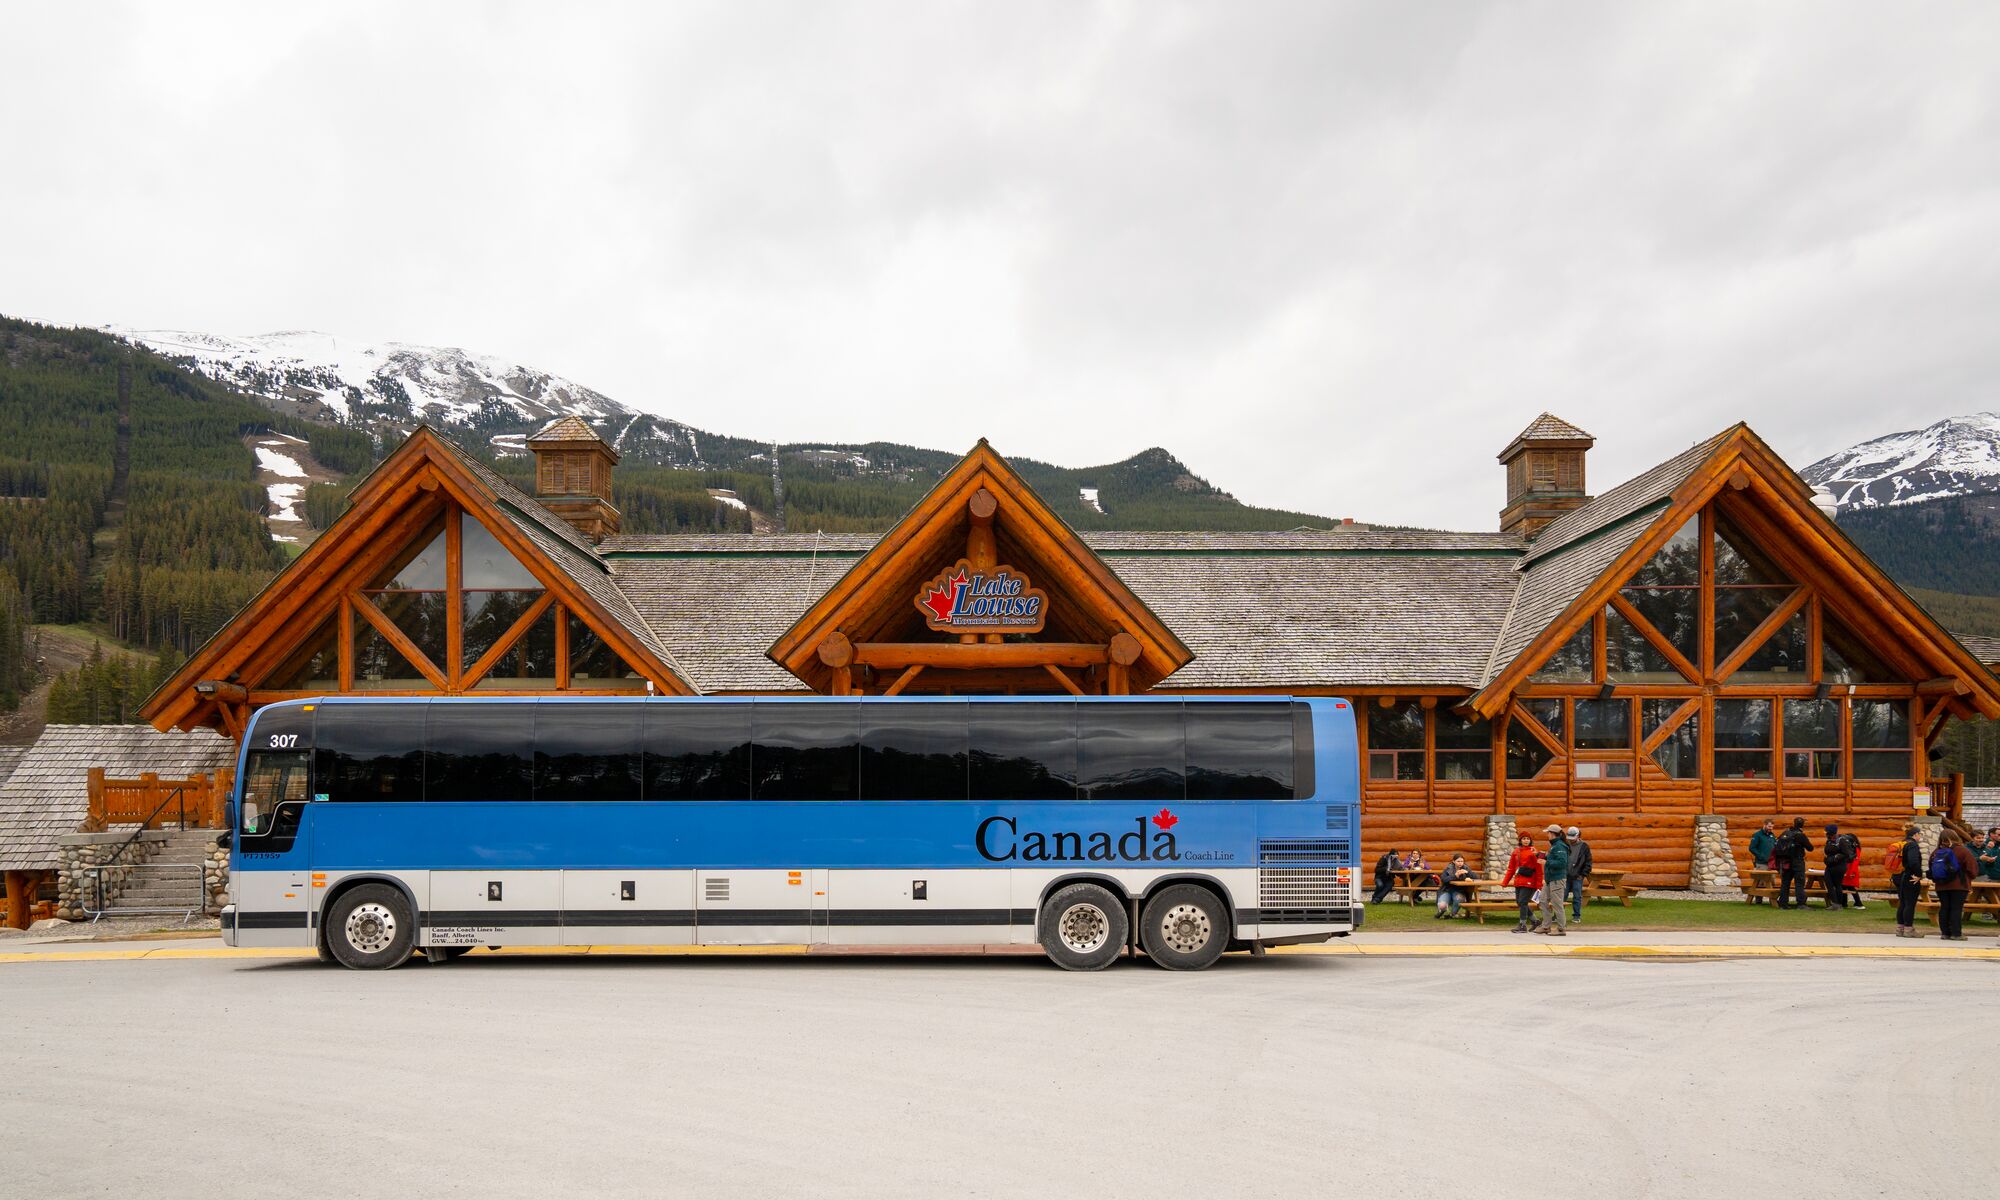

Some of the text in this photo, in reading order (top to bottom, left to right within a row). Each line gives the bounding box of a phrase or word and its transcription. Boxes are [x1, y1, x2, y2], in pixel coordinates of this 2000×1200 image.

[969, 573, 1021, 596] Lake
[951, 583, 1039, 616] Louise
[952, 617, 1037, 625] Mountain Resort
[269, 734, 298, 748] 307
[975, 816, 1234, 862] Canada Coach Line
